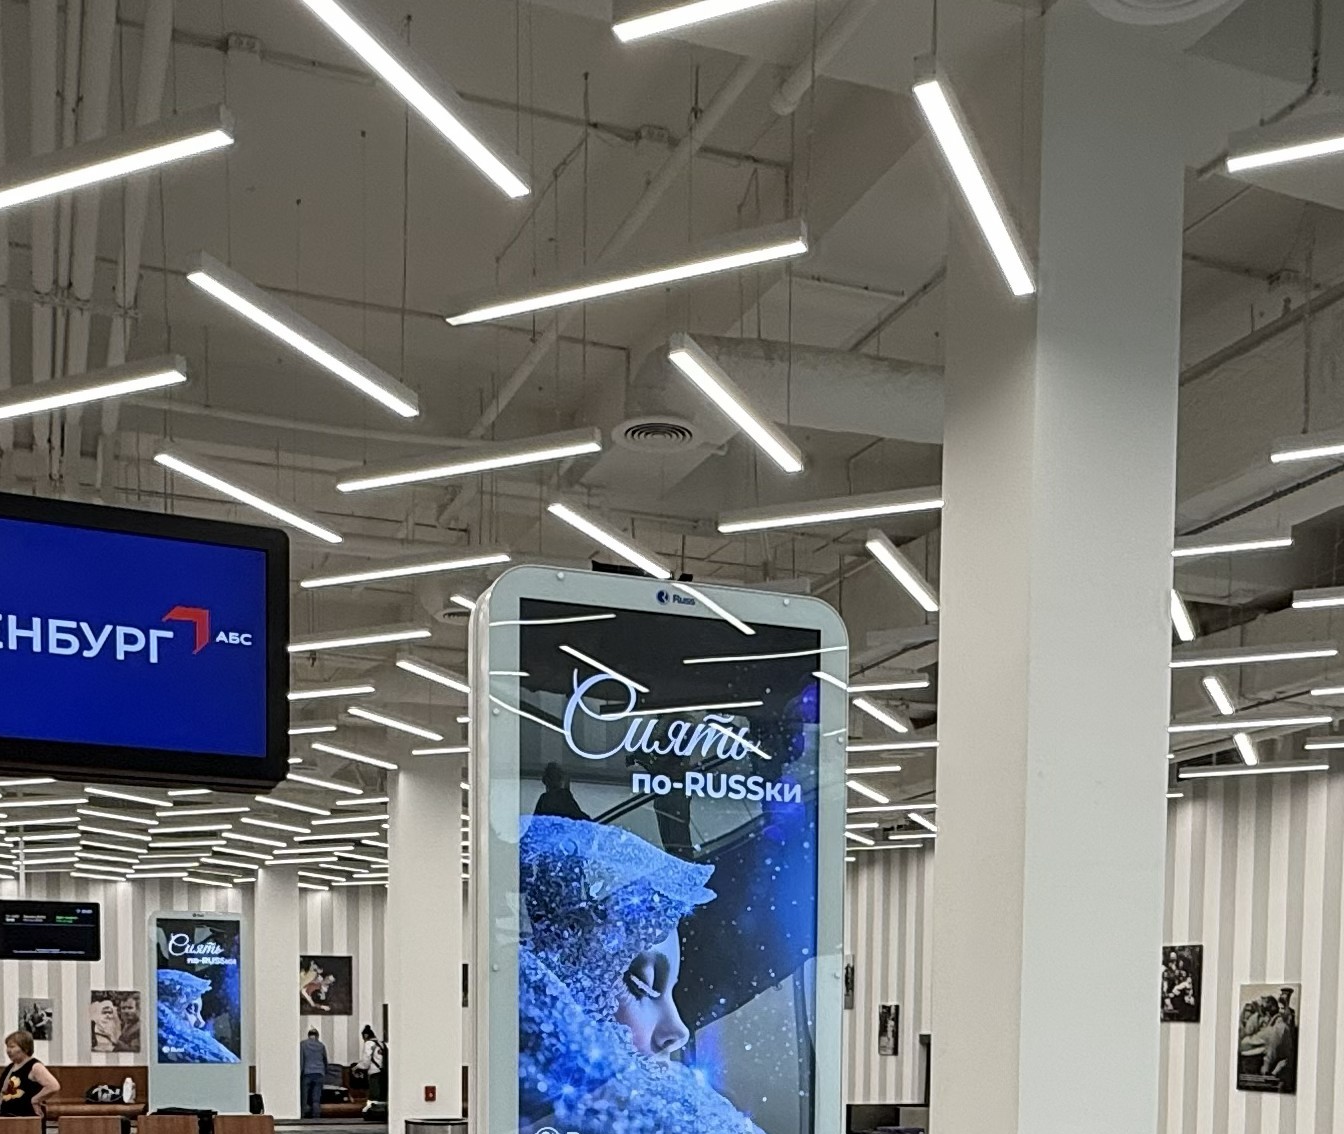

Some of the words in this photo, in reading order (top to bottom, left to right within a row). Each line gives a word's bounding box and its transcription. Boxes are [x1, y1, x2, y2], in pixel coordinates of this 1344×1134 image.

[215, 630, 253, 647] АБС
[564, 668, 762, 760] Сиять
[632, 771, 802, 804] по-RUSSки
